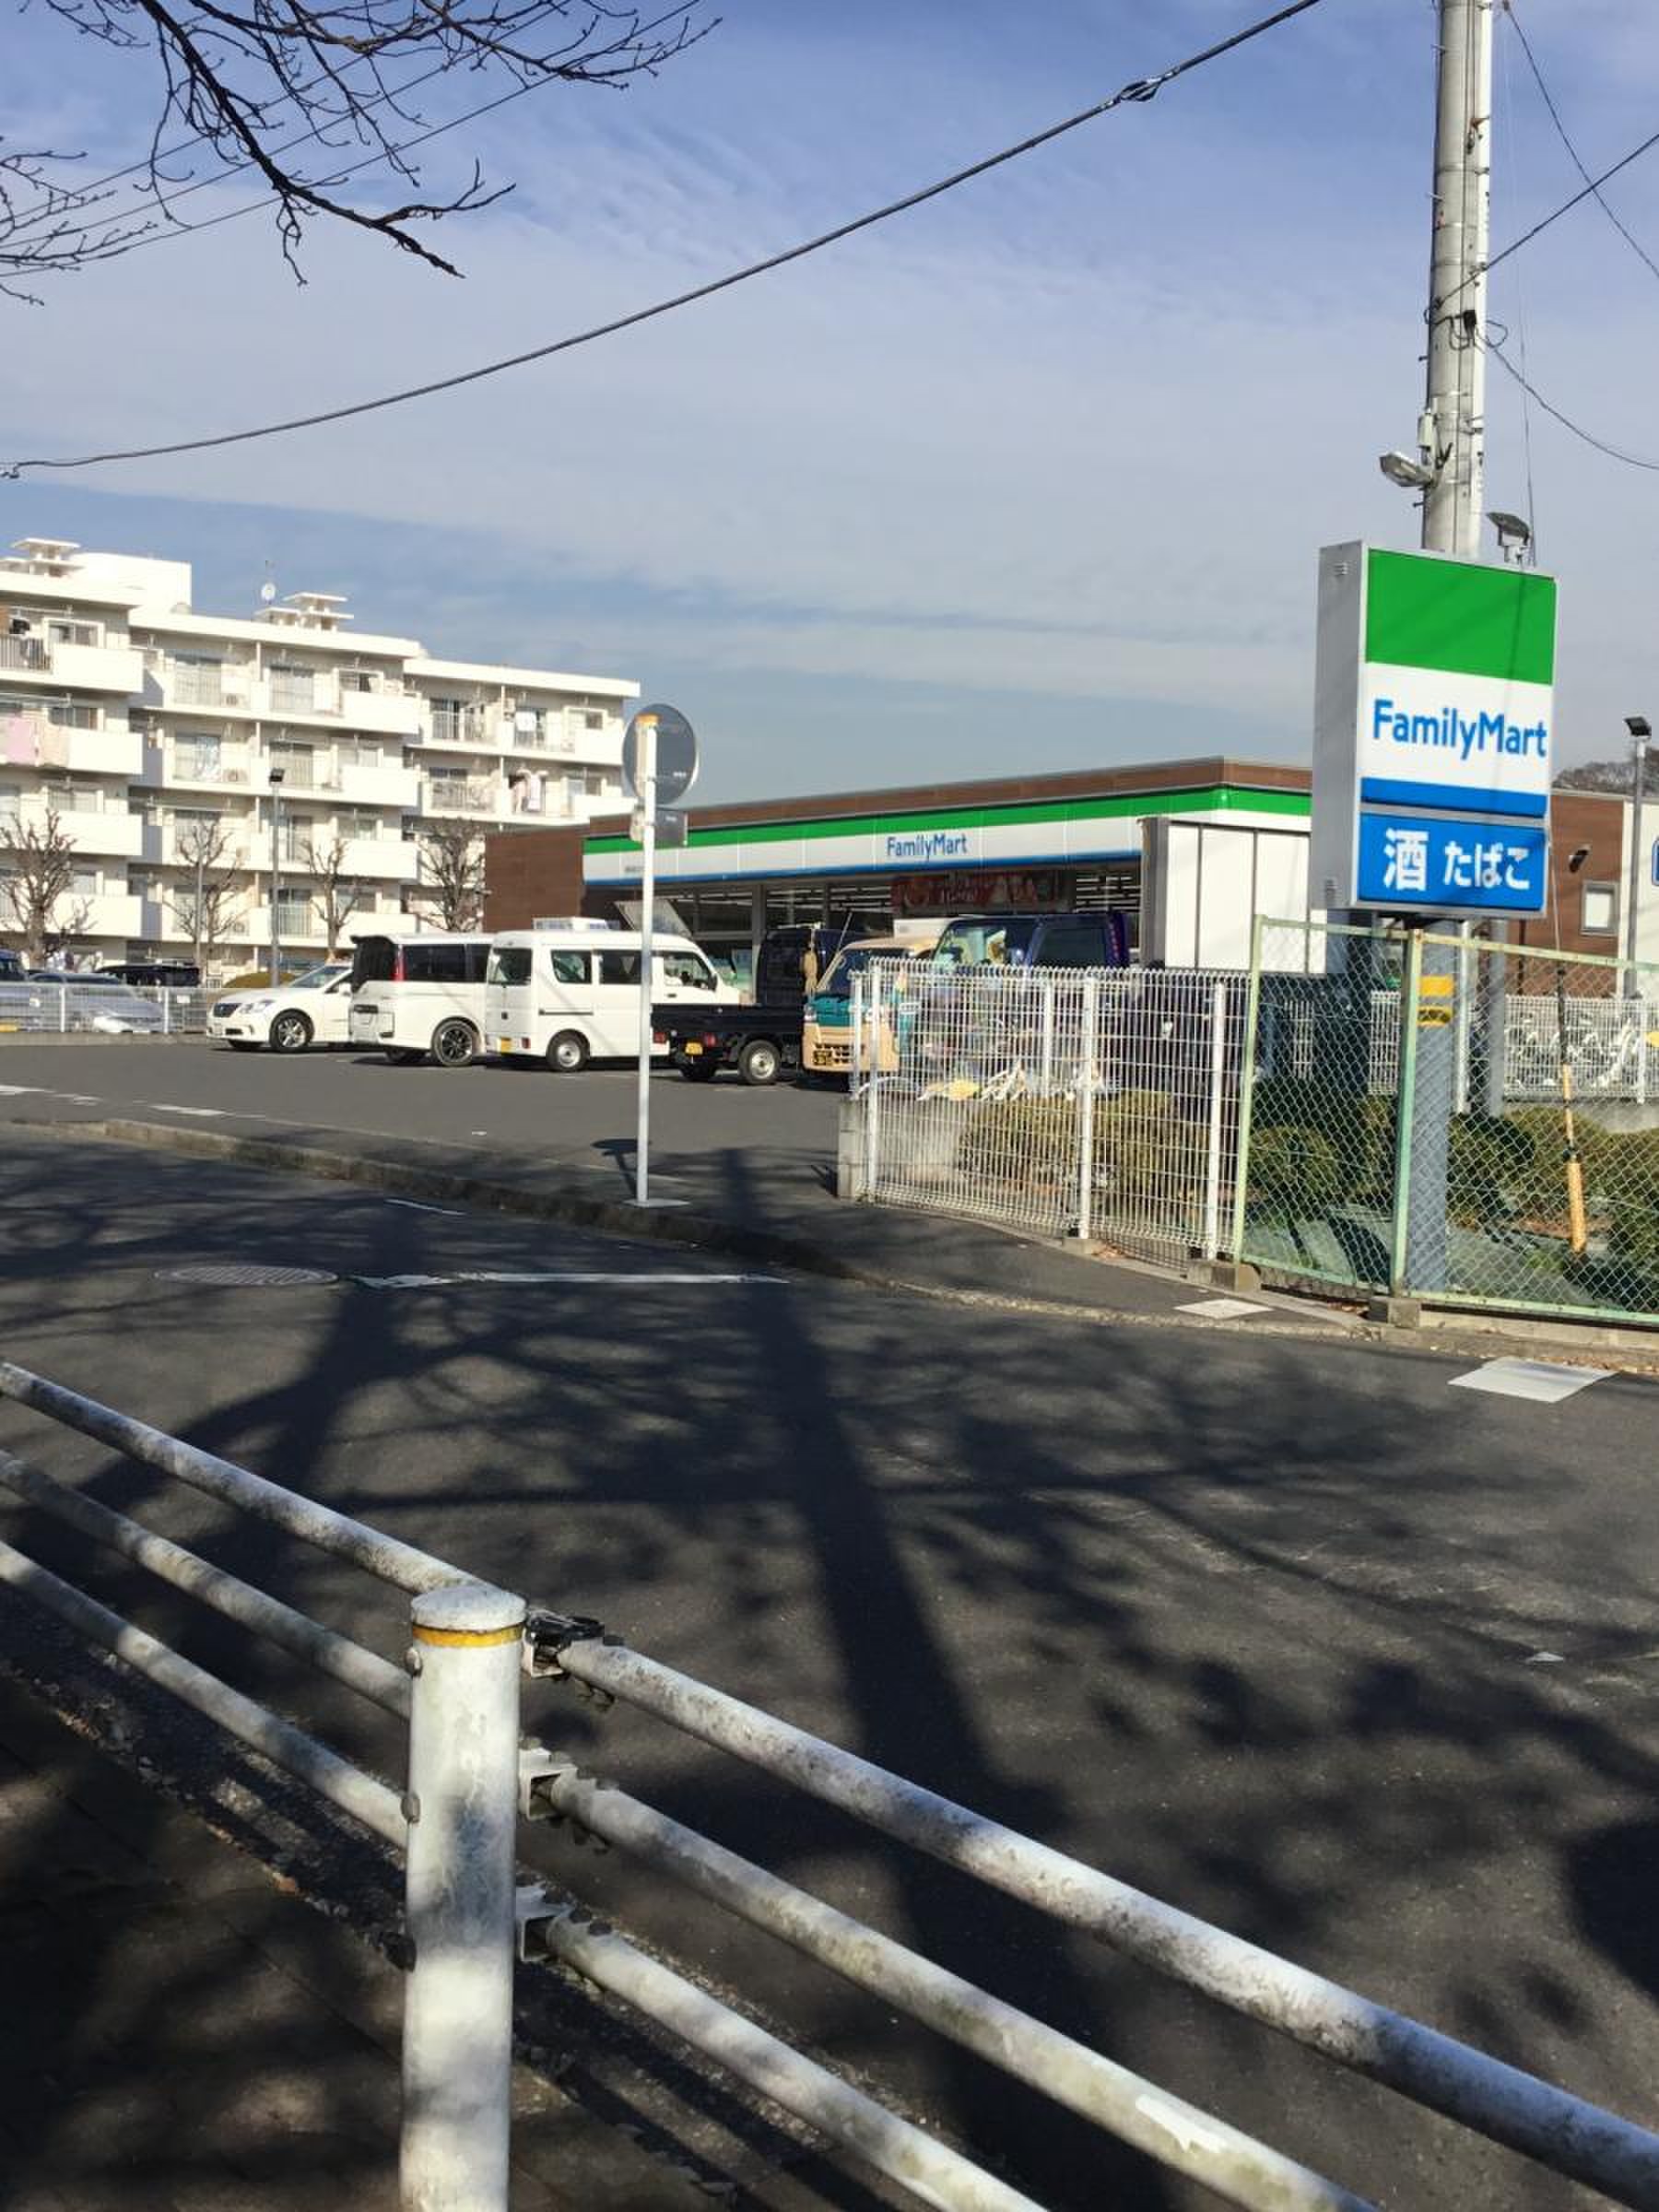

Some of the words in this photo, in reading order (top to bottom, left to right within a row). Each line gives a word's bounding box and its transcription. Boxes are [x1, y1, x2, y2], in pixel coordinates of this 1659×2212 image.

[1372, 698, 1547, 760] FamilyMart
[887, 832, 968, 861] FamilyMart
[1382, 827, 1430, 892] 酒
[1442, 840, 1530, 890] たばこ
